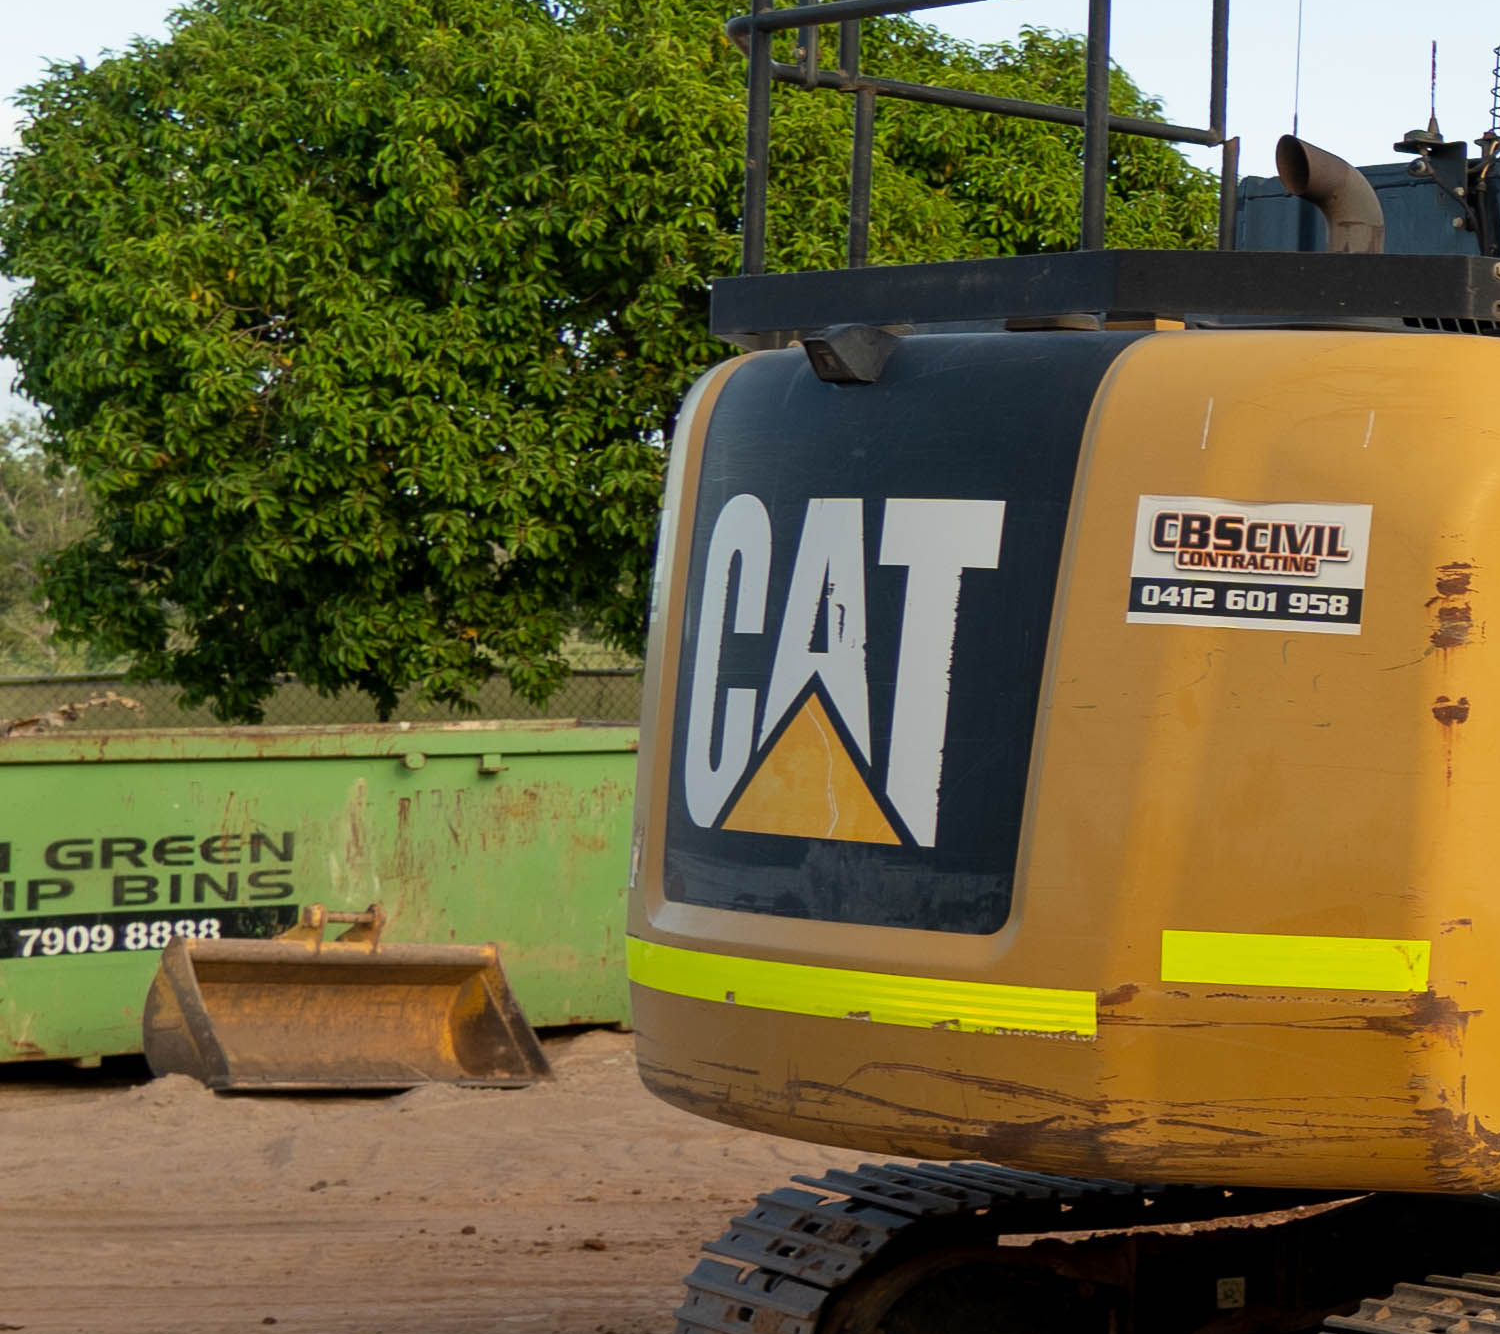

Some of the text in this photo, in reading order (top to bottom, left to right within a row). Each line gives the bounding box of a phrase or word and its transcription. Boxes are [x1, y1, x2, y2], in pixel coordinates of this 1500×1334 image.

[1178, 550, 1318, 573] CONTRACTING
[1141, 585, 1350, 616] 0412 601 958
[685, 494, 1006, 848] CAT
[44, 831, 296, 871] GREEN
[0, 869, 295, 912] IP BINS
[18, 918, 221, 957] 7909 8888
